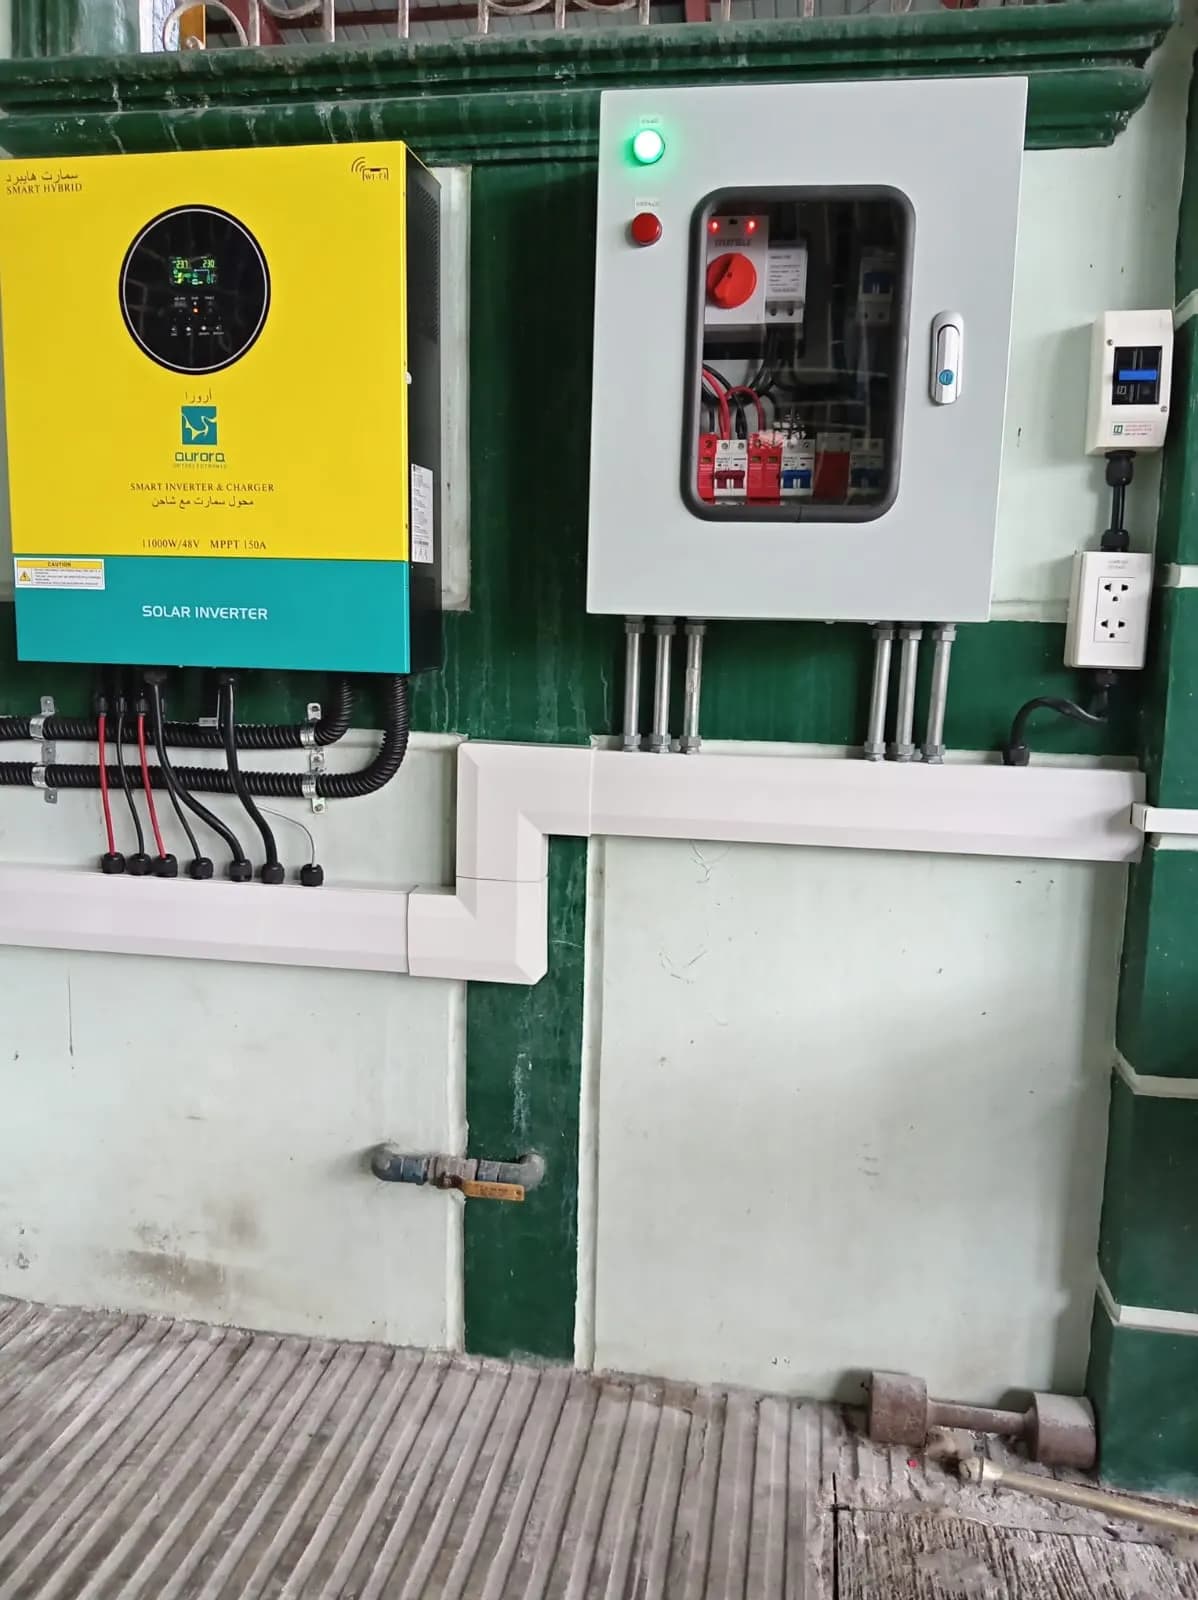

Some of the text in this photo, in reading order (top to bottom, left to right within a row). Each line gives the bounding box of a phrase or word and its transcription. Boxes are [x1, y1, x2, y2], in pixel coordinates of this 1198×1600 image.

[41, 168, 79, 183] سمارت
[6, 183, 83, 195] SMART HYBRID
[174, 451, 225, 463] aurora
[130, 482, 275, 493] SMART INVERTER & CHARGER
[194, 496, 226, 508] سمارت
[228, 496, 254, 509] محول
[142, 538, 268, 550] 11000W/48V MPPT 150A
[47, 560, 72, 569] CAUTION
[142, 605, 268, 621] SOLAR INVERTER
